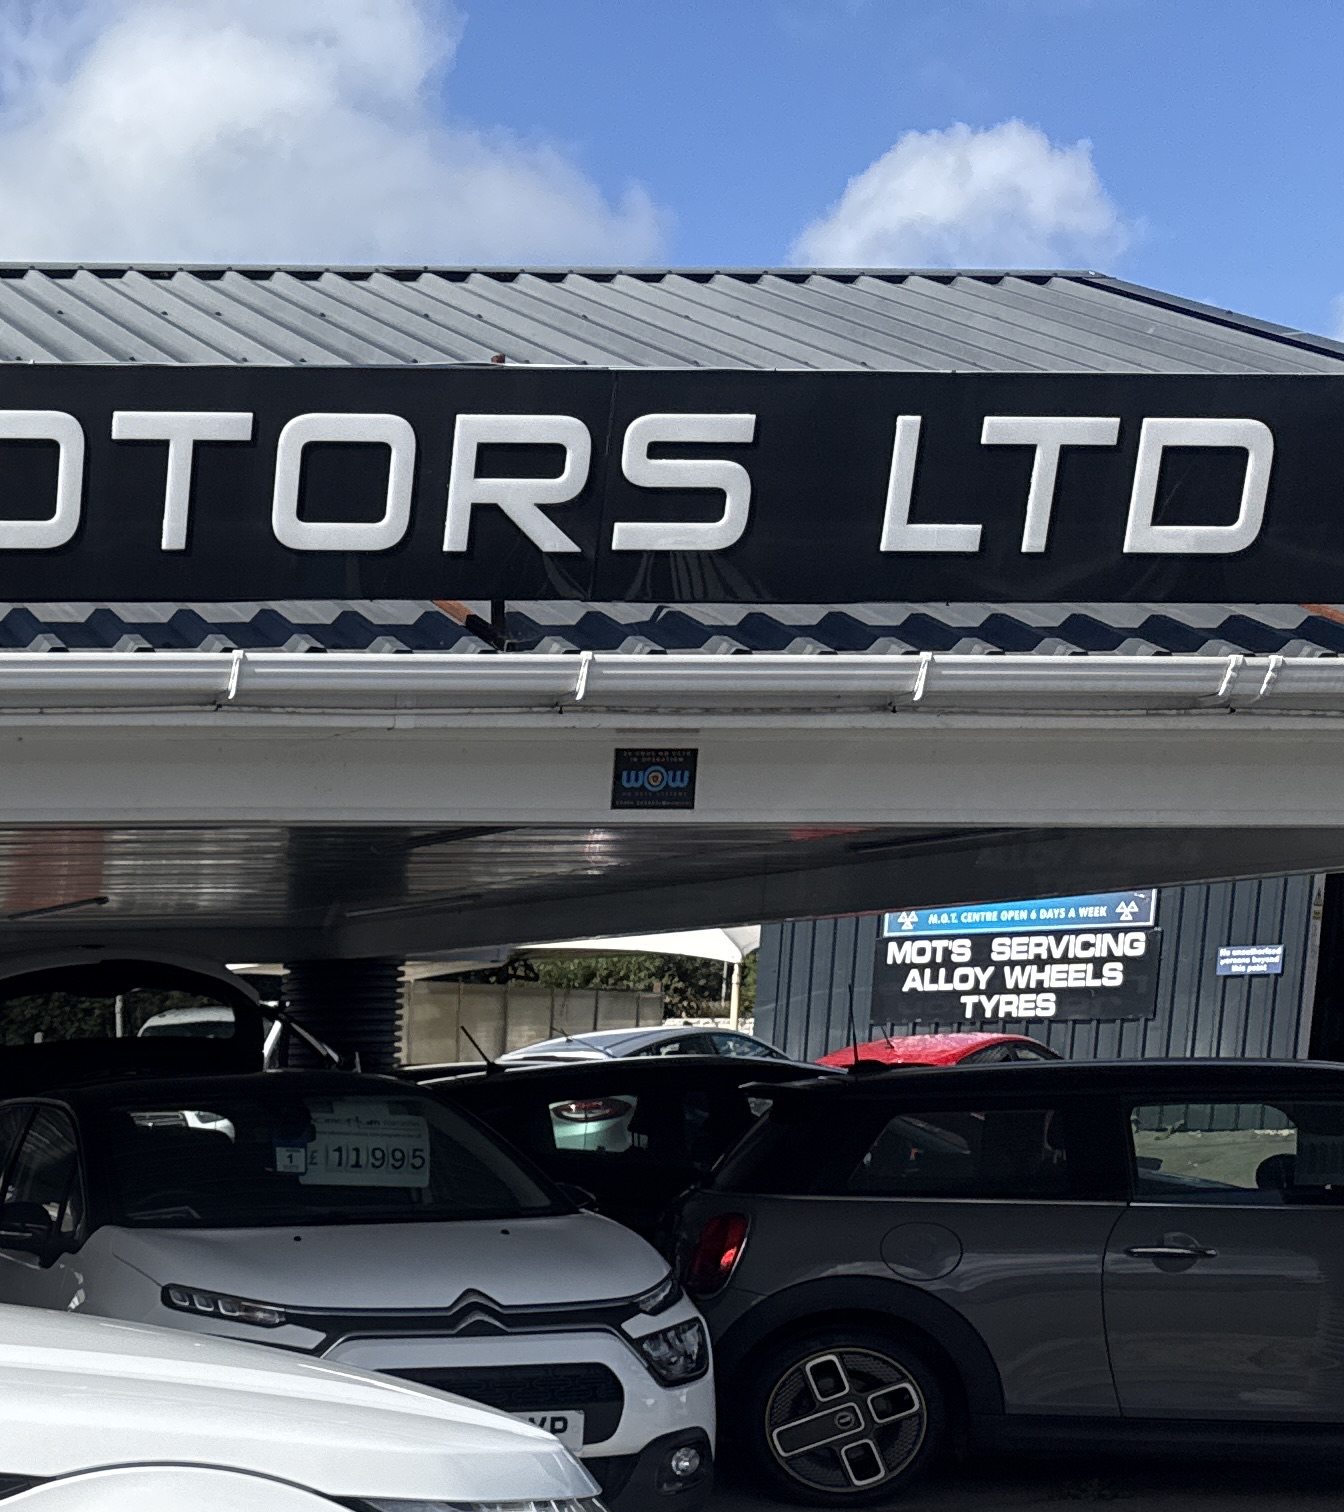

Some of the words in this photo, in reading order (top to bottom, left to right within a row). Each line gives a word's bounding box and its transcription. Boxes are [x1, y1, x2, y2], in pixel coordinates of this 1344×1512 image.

[879, 414, 1275, 554] LTD
[960, 911, 998, 924] CENTRE
[1000, 909, 1027, 922] OPEN
[1030, 909, 1037, 920] 6
[1039, 908, 1066, 920] DAYS
[1068, 907, 1076, 918] A
[1078, 905, 1108, 918] WEEK
[886, 938, 973, 965] MOT'S
[991, 931, 1147, 962] SERVICING
[901, 966, 995, 992] ALLOY
[1004, 961, 1124, 989] WHEELS
[960, 992, 1057, 1019] TYRES
